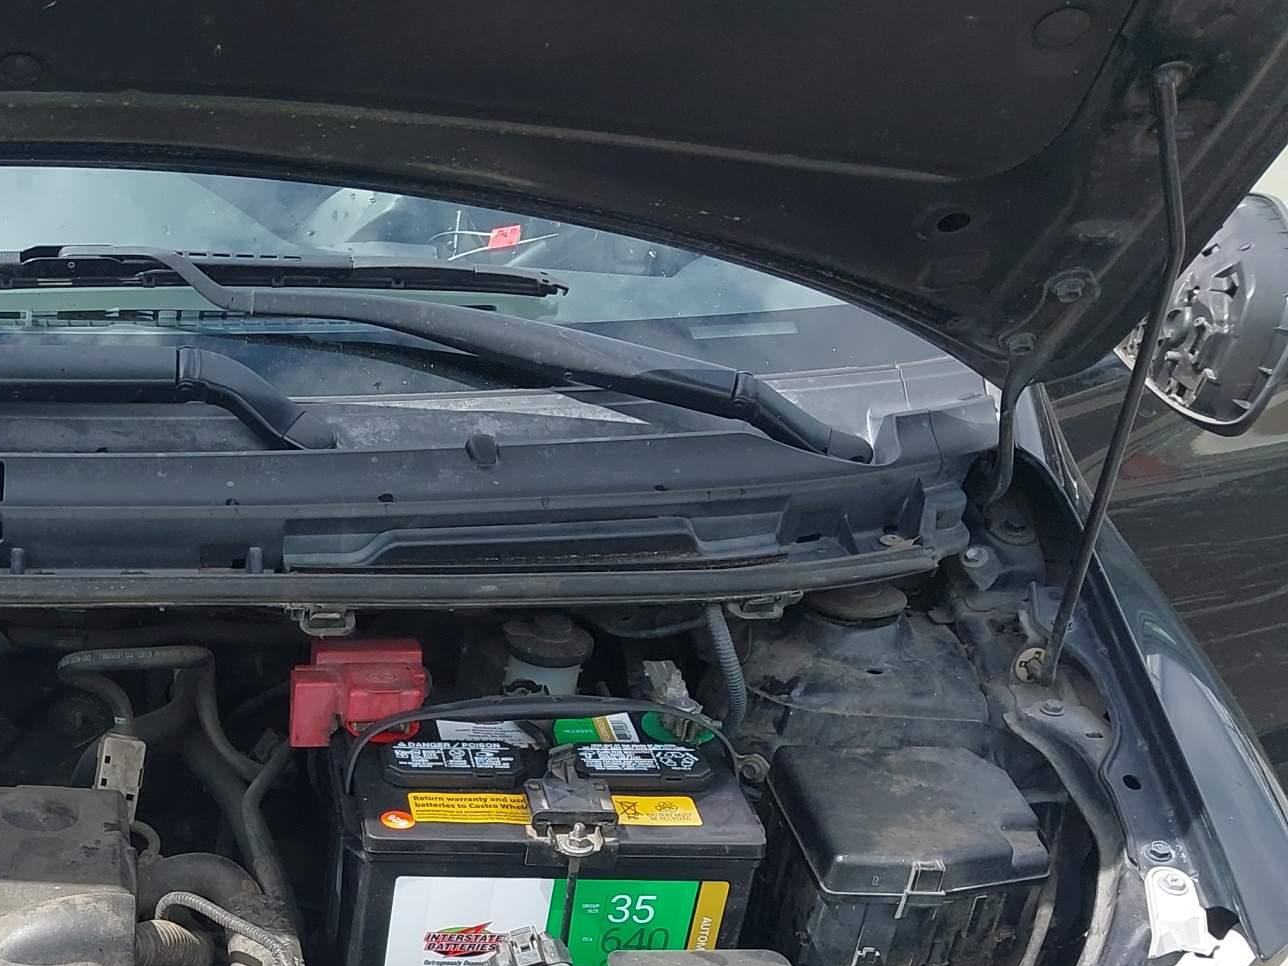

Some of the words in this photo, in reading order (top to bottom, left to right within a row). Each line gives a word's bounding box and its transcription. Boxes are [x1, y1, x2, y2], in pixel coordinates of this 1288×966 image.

[607, 894, 657, 924] 35
[424, 933, 505, 943] INTERSTATE
[600, 927, 670, 953] 640
[426, 942, 496, 951] BATTERIES
[424, 959, 463, 966] Outrageously
